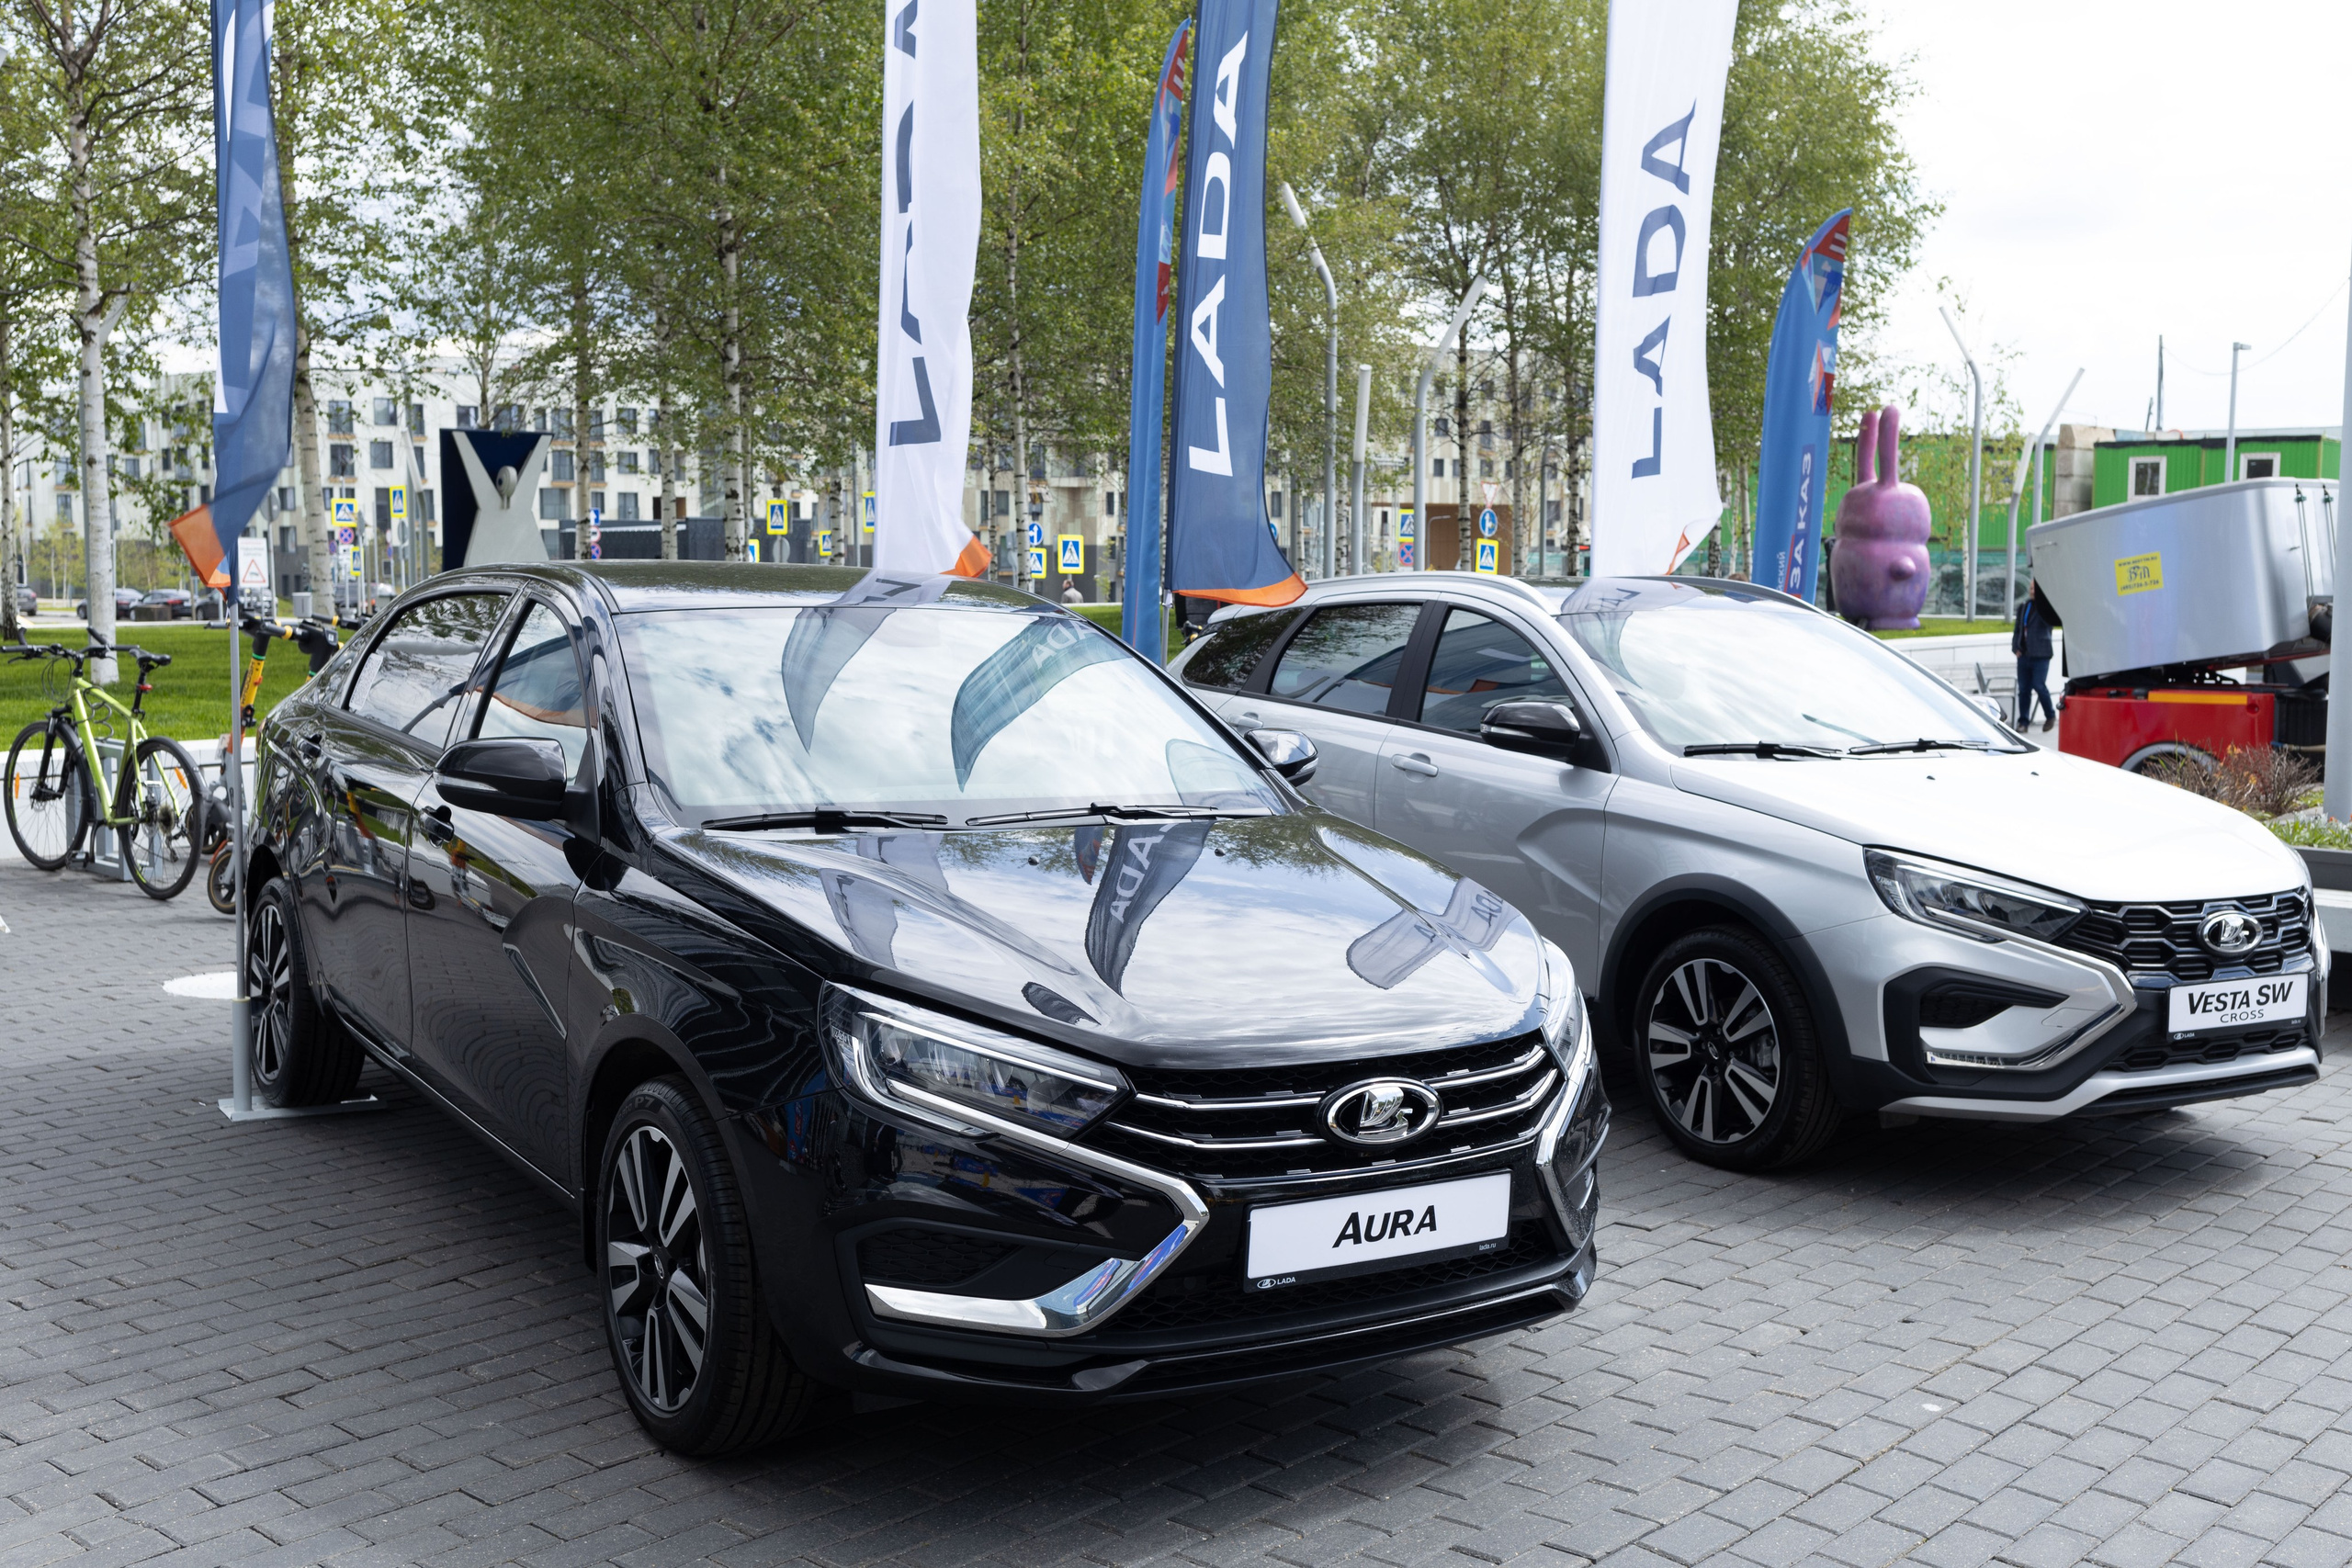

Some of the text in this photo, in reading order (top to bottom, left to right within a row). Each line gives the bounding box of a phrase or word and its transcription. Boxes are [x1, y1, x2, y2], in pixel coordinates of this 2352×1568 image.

[1189, 30, 1249, 477] LADA
[1632, 96, 1697, 479] LADA
[2256, 981, 2294, 1007] SW
[2220, 1009, 2265, 1023] CROSS
[1478, 1243, 1497, 1251] lada.ru
[1276, 1276, 1296, 1285] LADA
